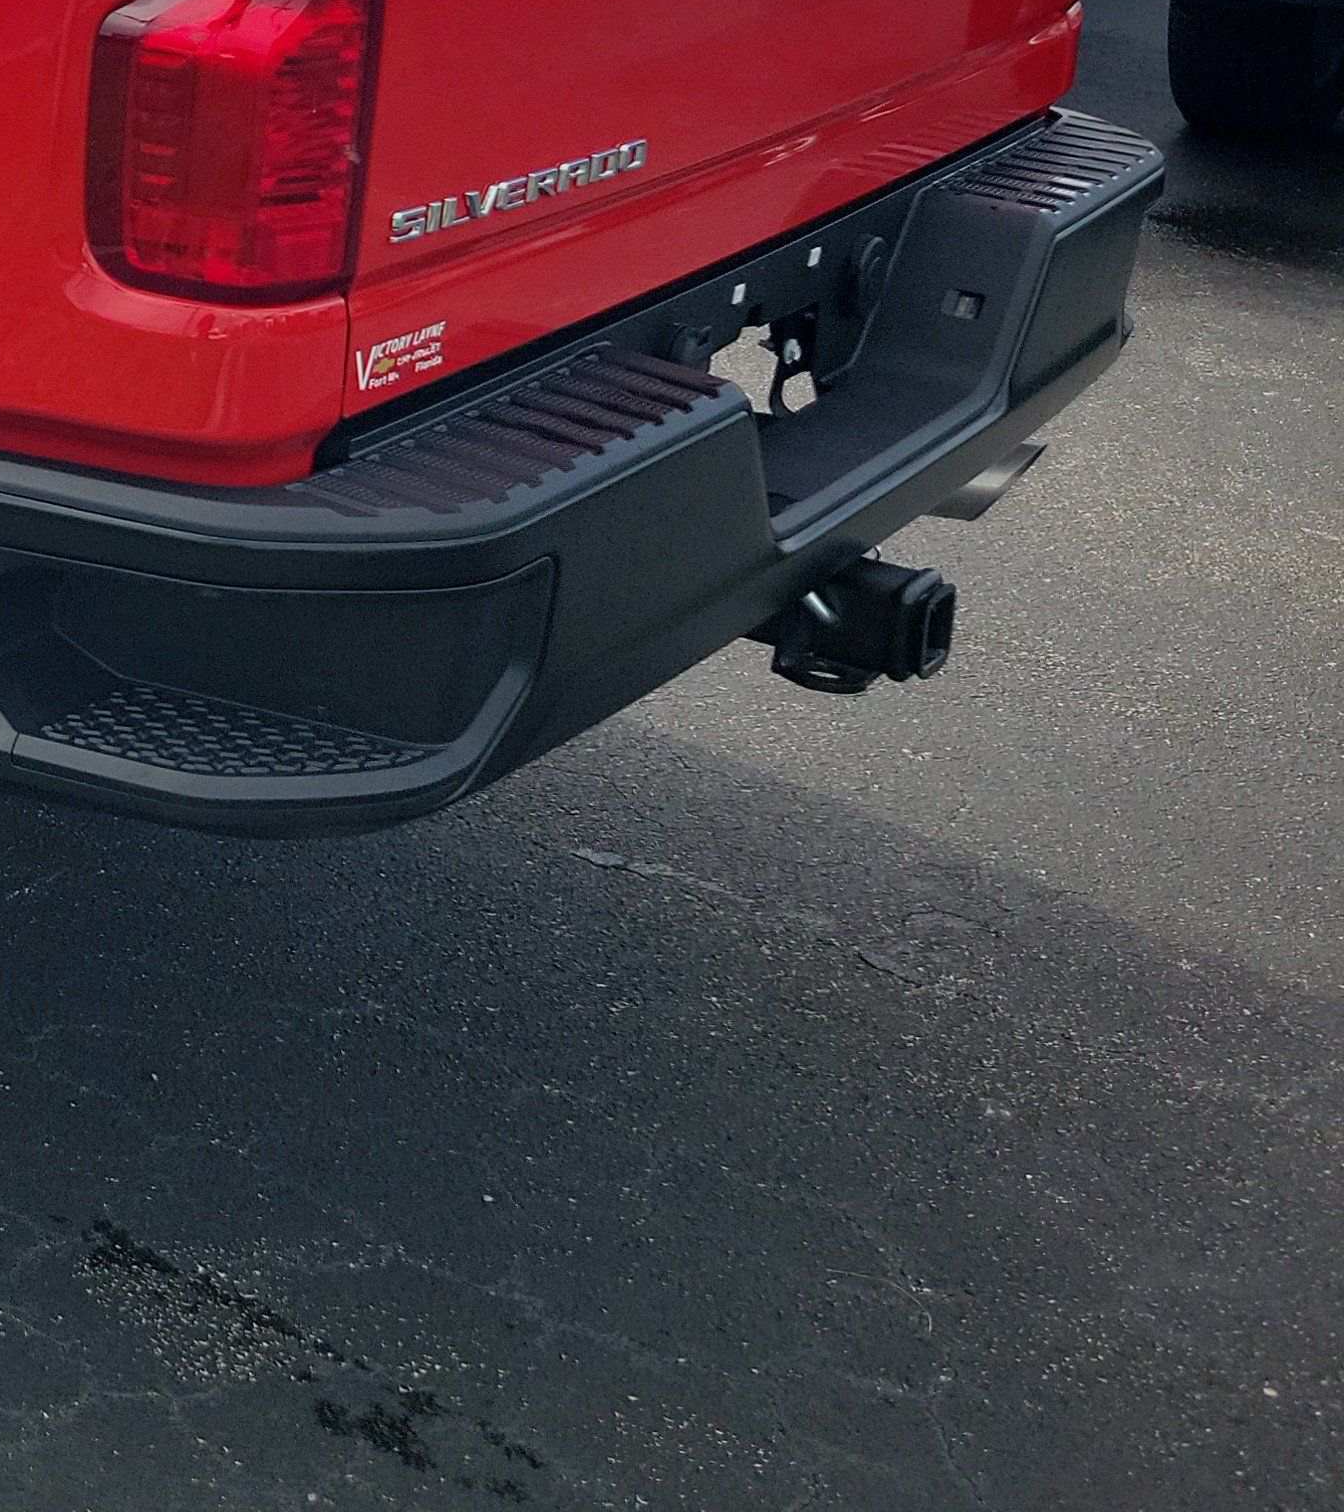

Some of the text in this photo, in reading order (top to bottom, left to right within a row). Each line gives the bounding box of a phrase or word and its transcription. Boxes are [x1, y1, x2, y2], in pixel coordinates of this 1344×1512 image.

[389, 138, 648, 244] SILVERADO
[355, 320, 447, 391] VICTORY LAYNE
